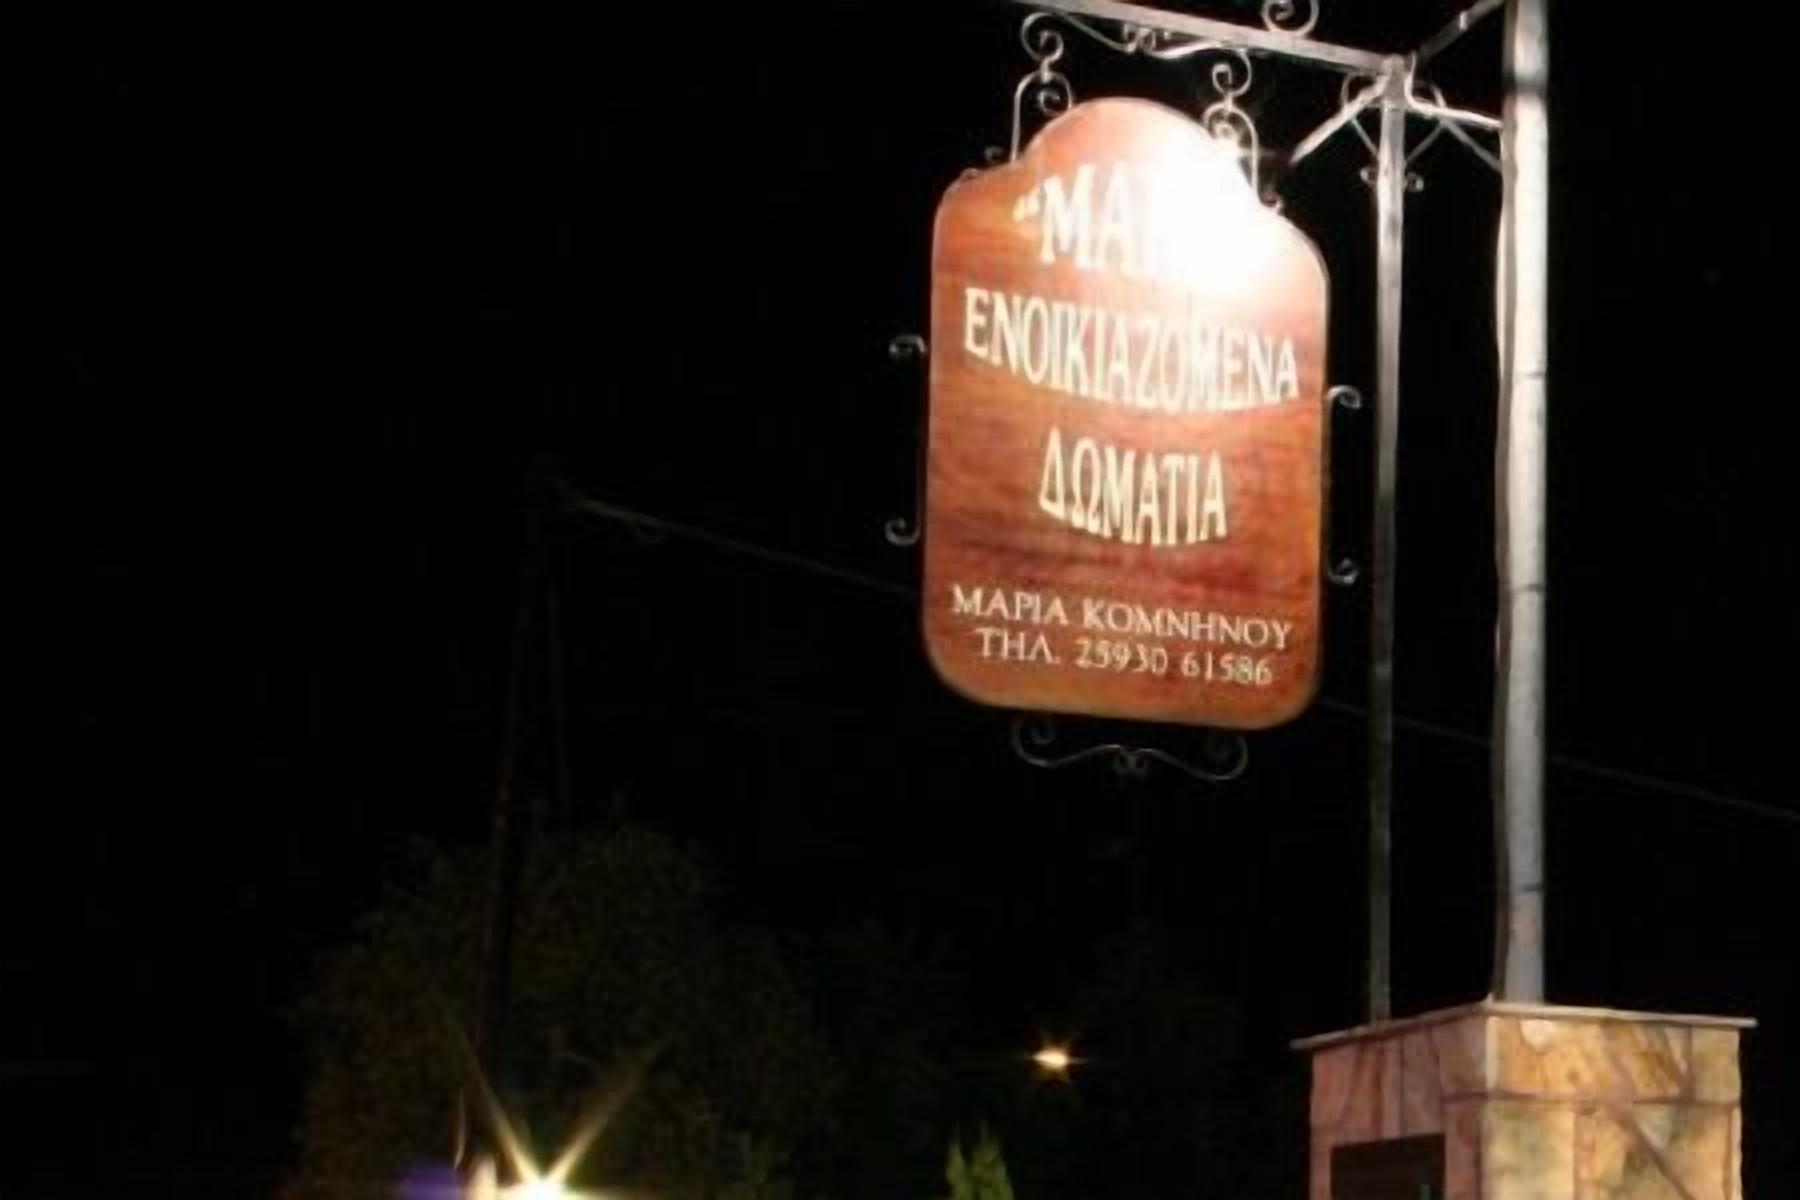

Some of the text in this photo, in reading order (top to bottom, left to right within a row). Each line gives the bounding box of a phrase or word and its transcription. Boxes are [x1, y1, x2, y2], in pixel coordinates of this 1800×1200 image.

[963, 285, 1299, 416] ΕΝΟΙΚΙΑΖΟΜΕΝΑ
[1037, 424, 1228, 547] ΔΩΜΑΤΙΑ
[952, 583, 1293, 651] ΜΑΡΙΑ ΚΟΜΝΗΝΟΥ
[973, 626, 1273, 688] ΤΗΛ. 25930 61586
